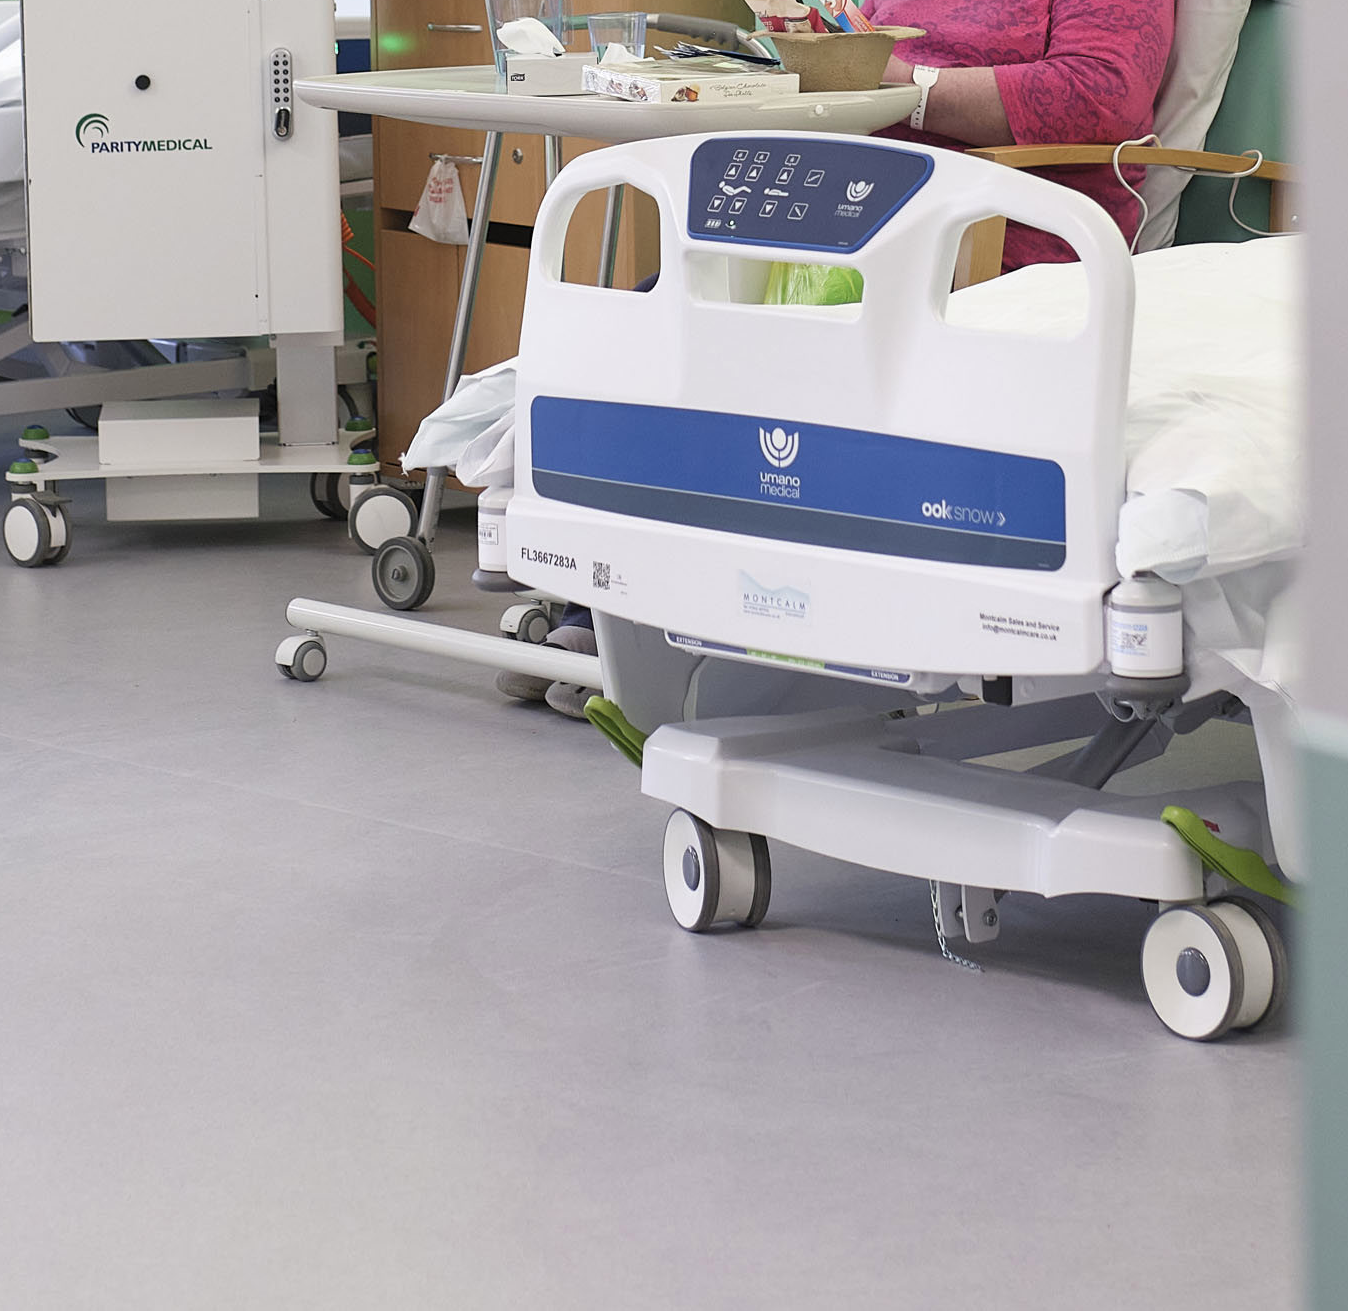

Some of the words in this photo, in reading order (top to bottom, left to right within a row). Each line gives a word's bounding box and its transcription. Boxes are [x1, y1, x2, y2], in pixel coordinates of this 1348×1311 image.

[91, 139, 213, 153] PARITYMEDICAL
[835, 209, 860, 218] medical
[837, 203, 863, 212] umano
[760, 471, 800, 487] umano
[760, 483, 800, 498] medical
[521, 547, 577, 570] FL3667283A
[743, 593, 806, 610] MONTCALM
[979, 612, 1007, 623] Montcalm
[1009, 617, 1024, 626] Sales
[1038, 621, 1060, 631] Service
[676, 636, 703, 646] EXTENSION
[871, 670, 899, 681] EXTENSION
